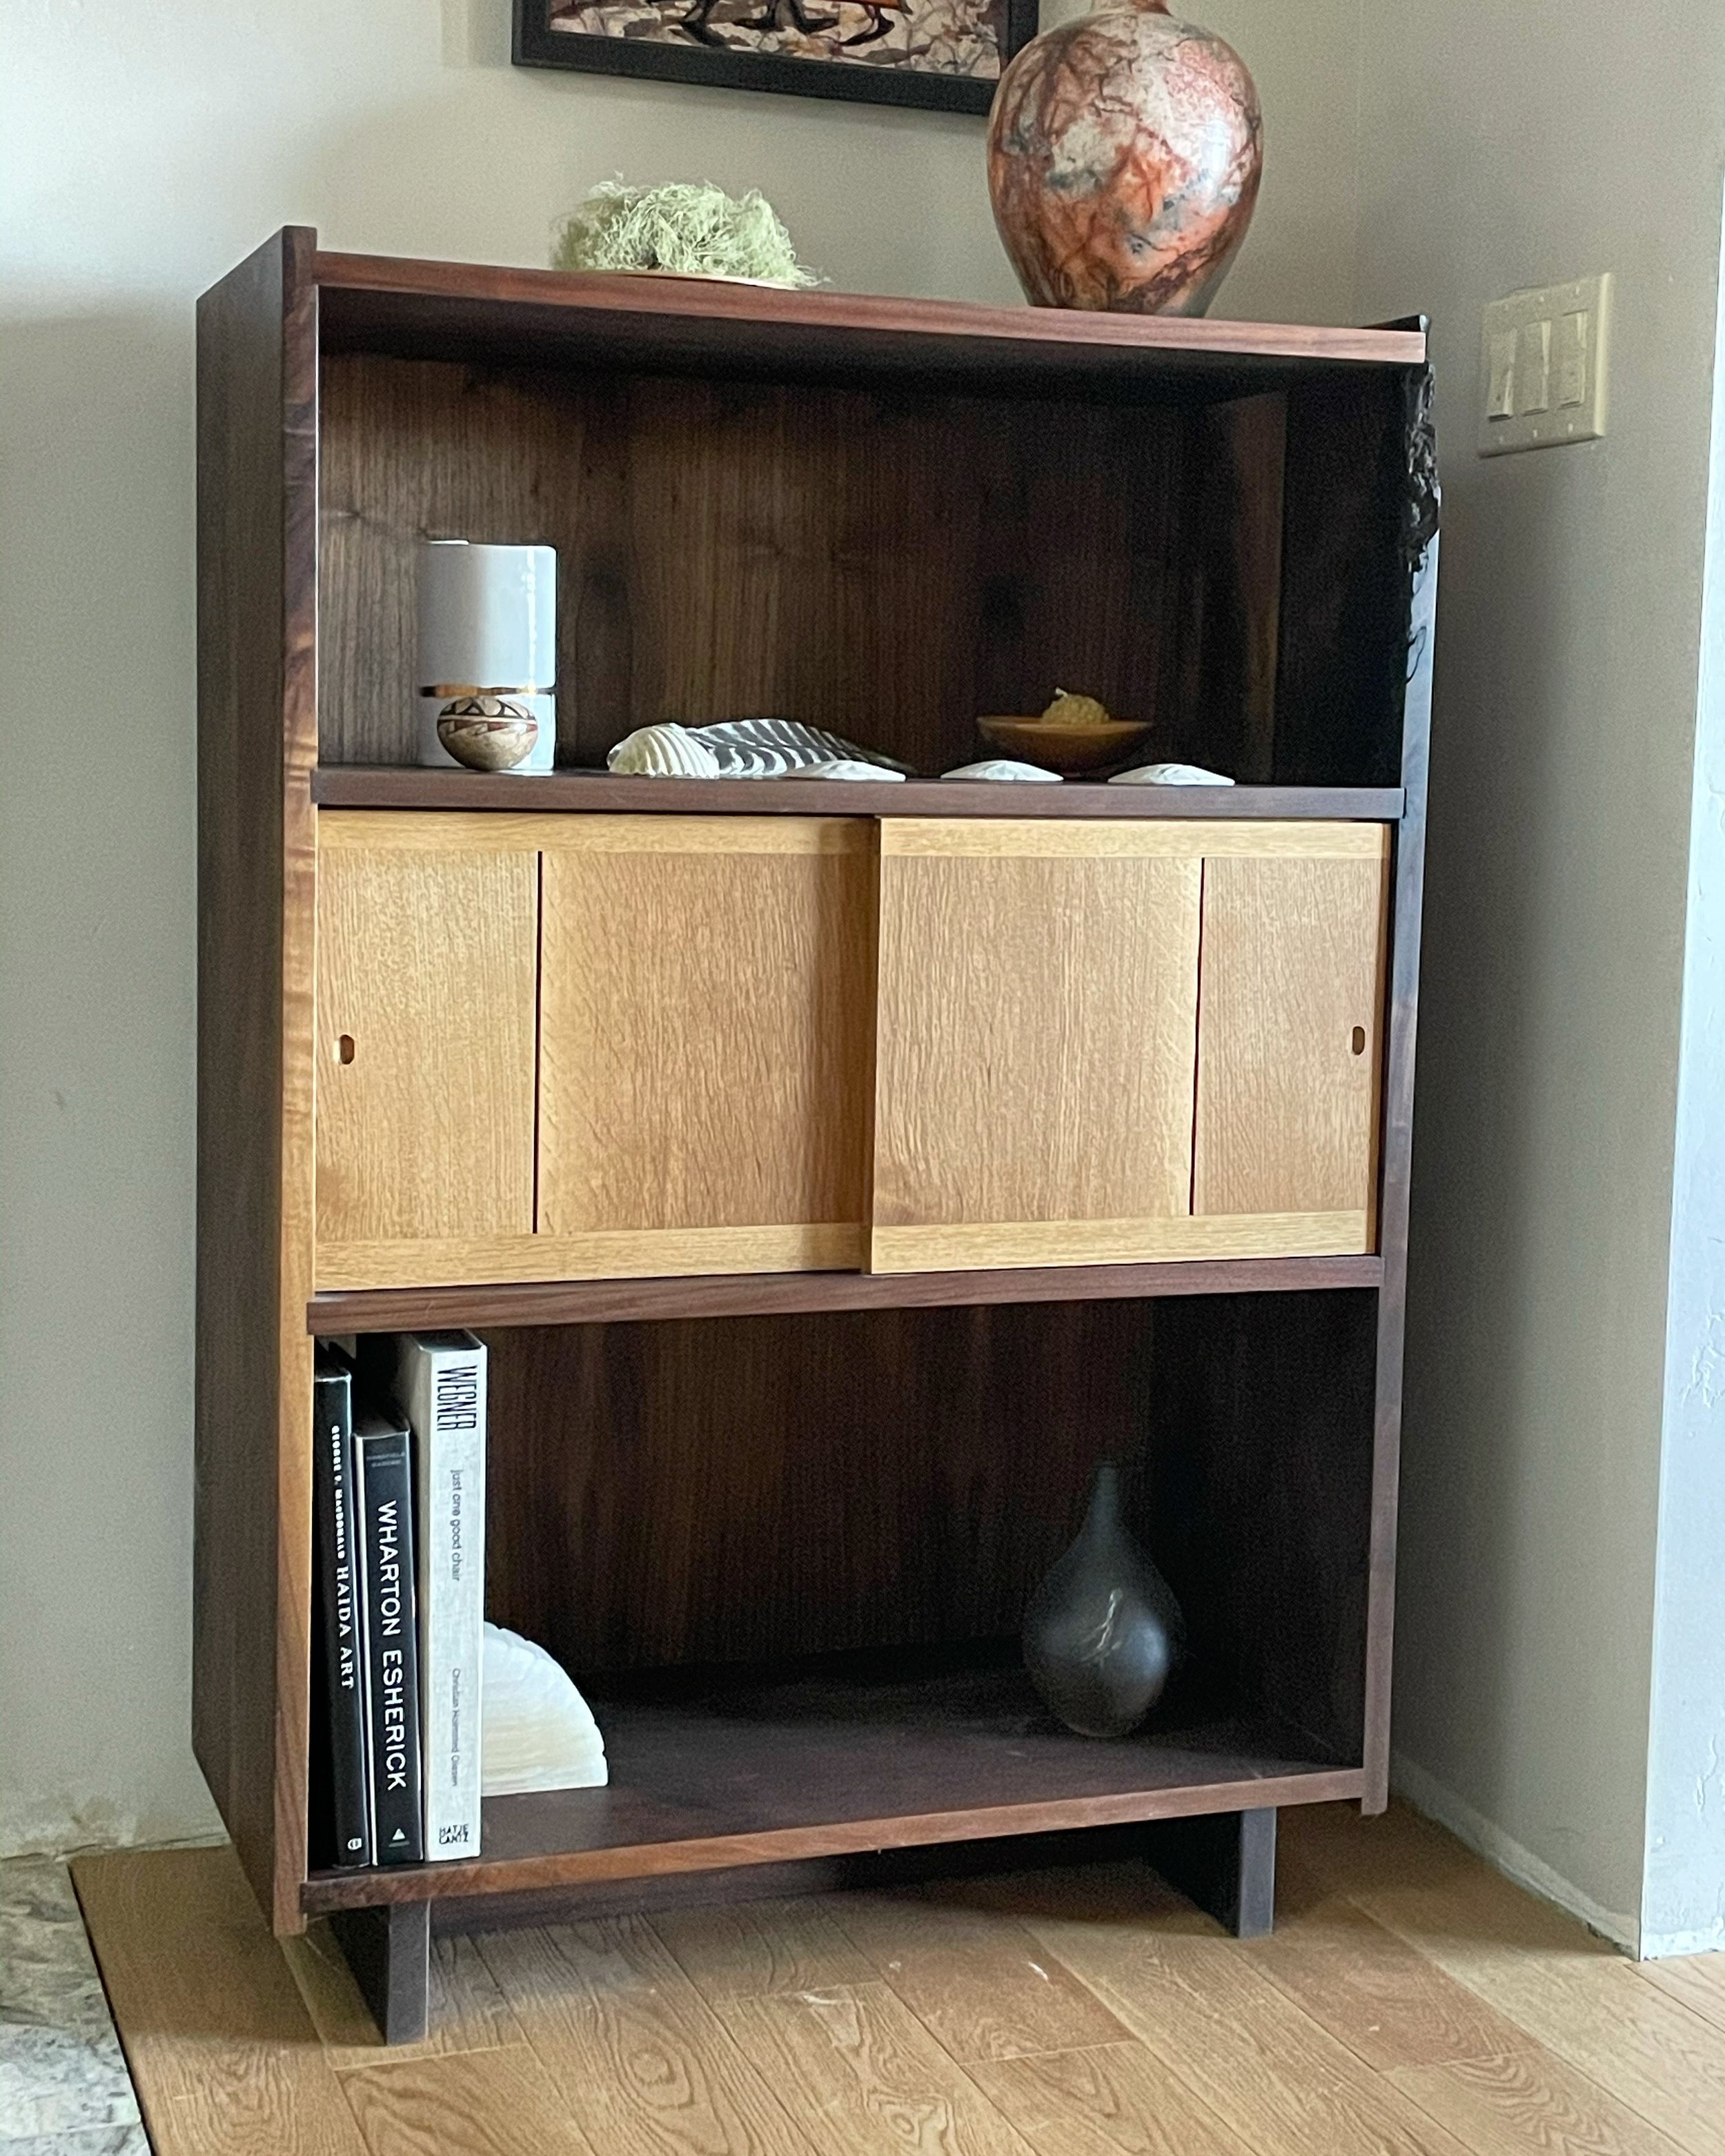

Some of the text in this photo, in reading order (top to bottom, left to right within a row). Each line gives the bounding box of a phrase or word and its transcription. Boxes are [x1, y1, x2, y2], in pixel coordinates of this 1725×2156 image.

[437, 1365, 477, 1432] WEGNER
[450, 1469, 464, 1581] just one good chair
[337, 1565, 351, 1637] HAIDA
[340, 1647, 354, 1689] ART
[378, 1500, 406, 1791] WHARTON ESHERICK
